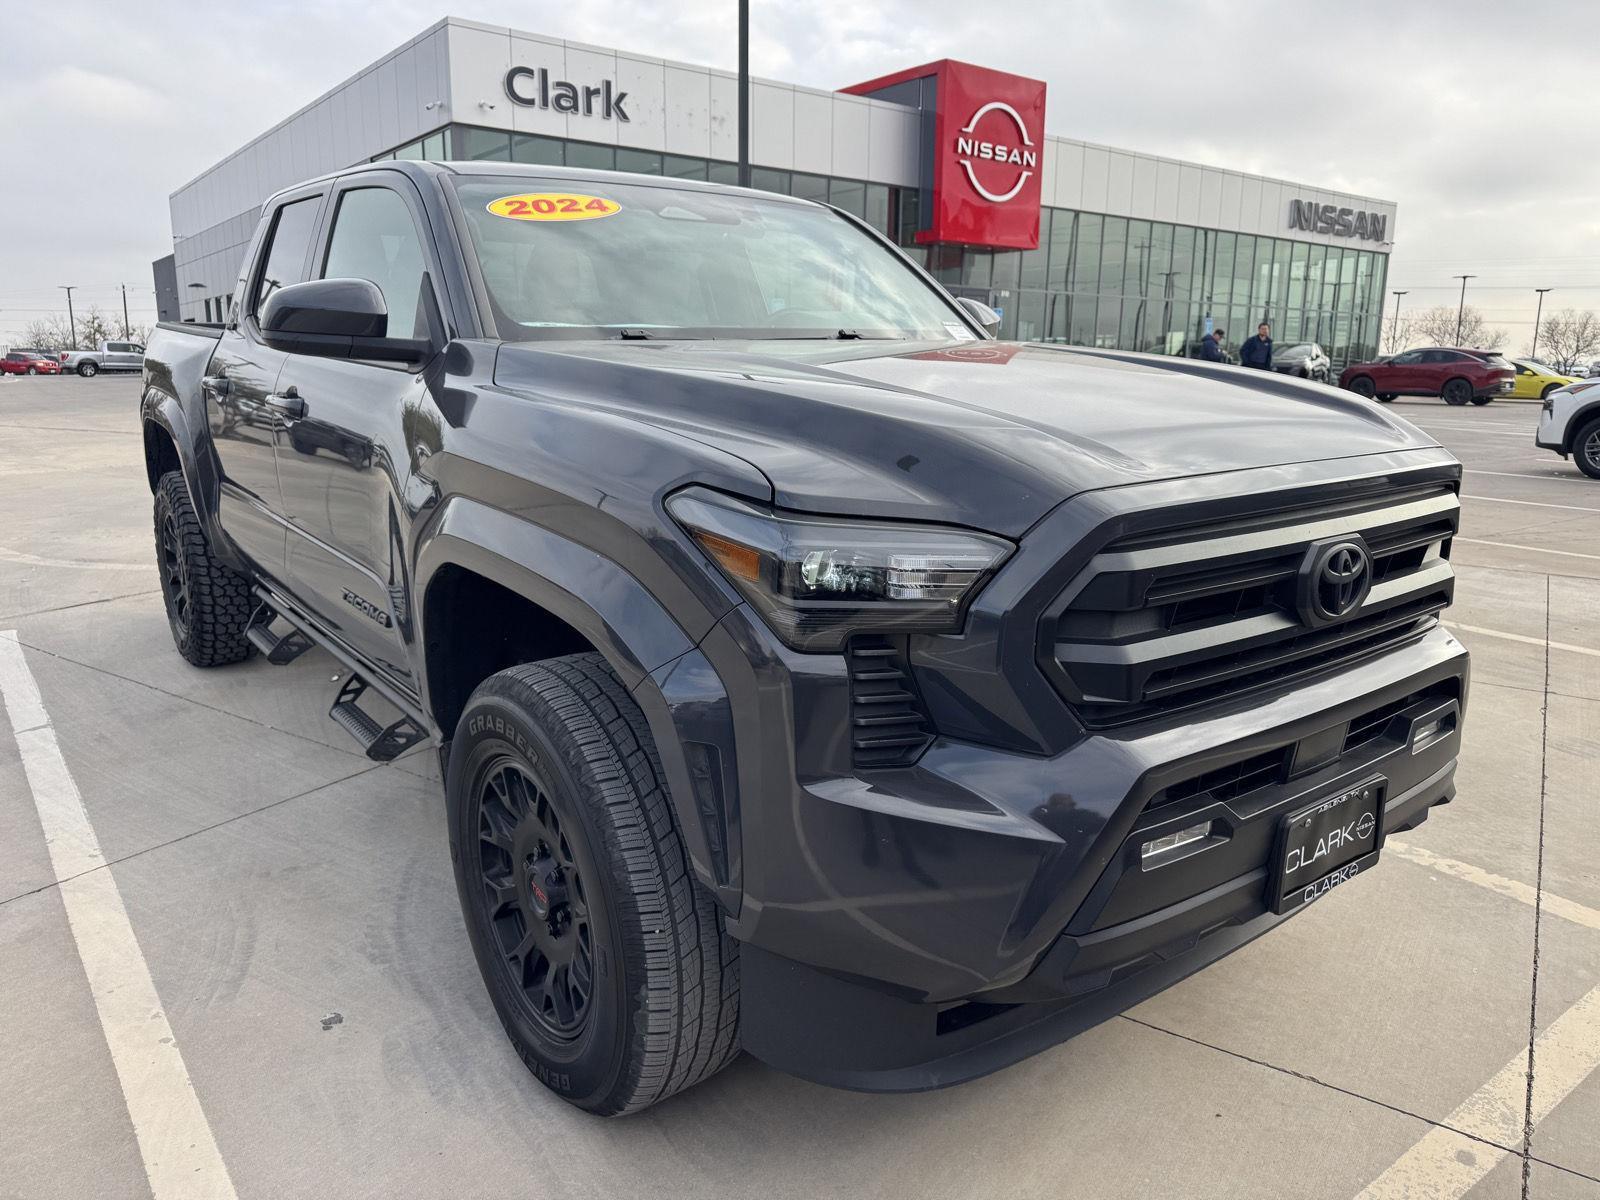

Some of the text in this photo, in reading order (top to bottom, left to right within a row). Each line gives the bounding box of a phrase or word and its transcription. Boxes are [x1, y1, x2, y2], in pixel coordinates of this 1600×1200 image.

[504, 66, 630, 122] Clark
[957, 137, 1036, 167] NISSAN
[505, 198, 610, 215] 2024
[1288, 199, 1387, 242] NISSAN
[341, 586, 392, 628] TACOMA
[469, 715, 539, 765] GRABBER
[1285, 821, 1354, 874] CLARK
[1304, 867, 1350, 902] CLARK
